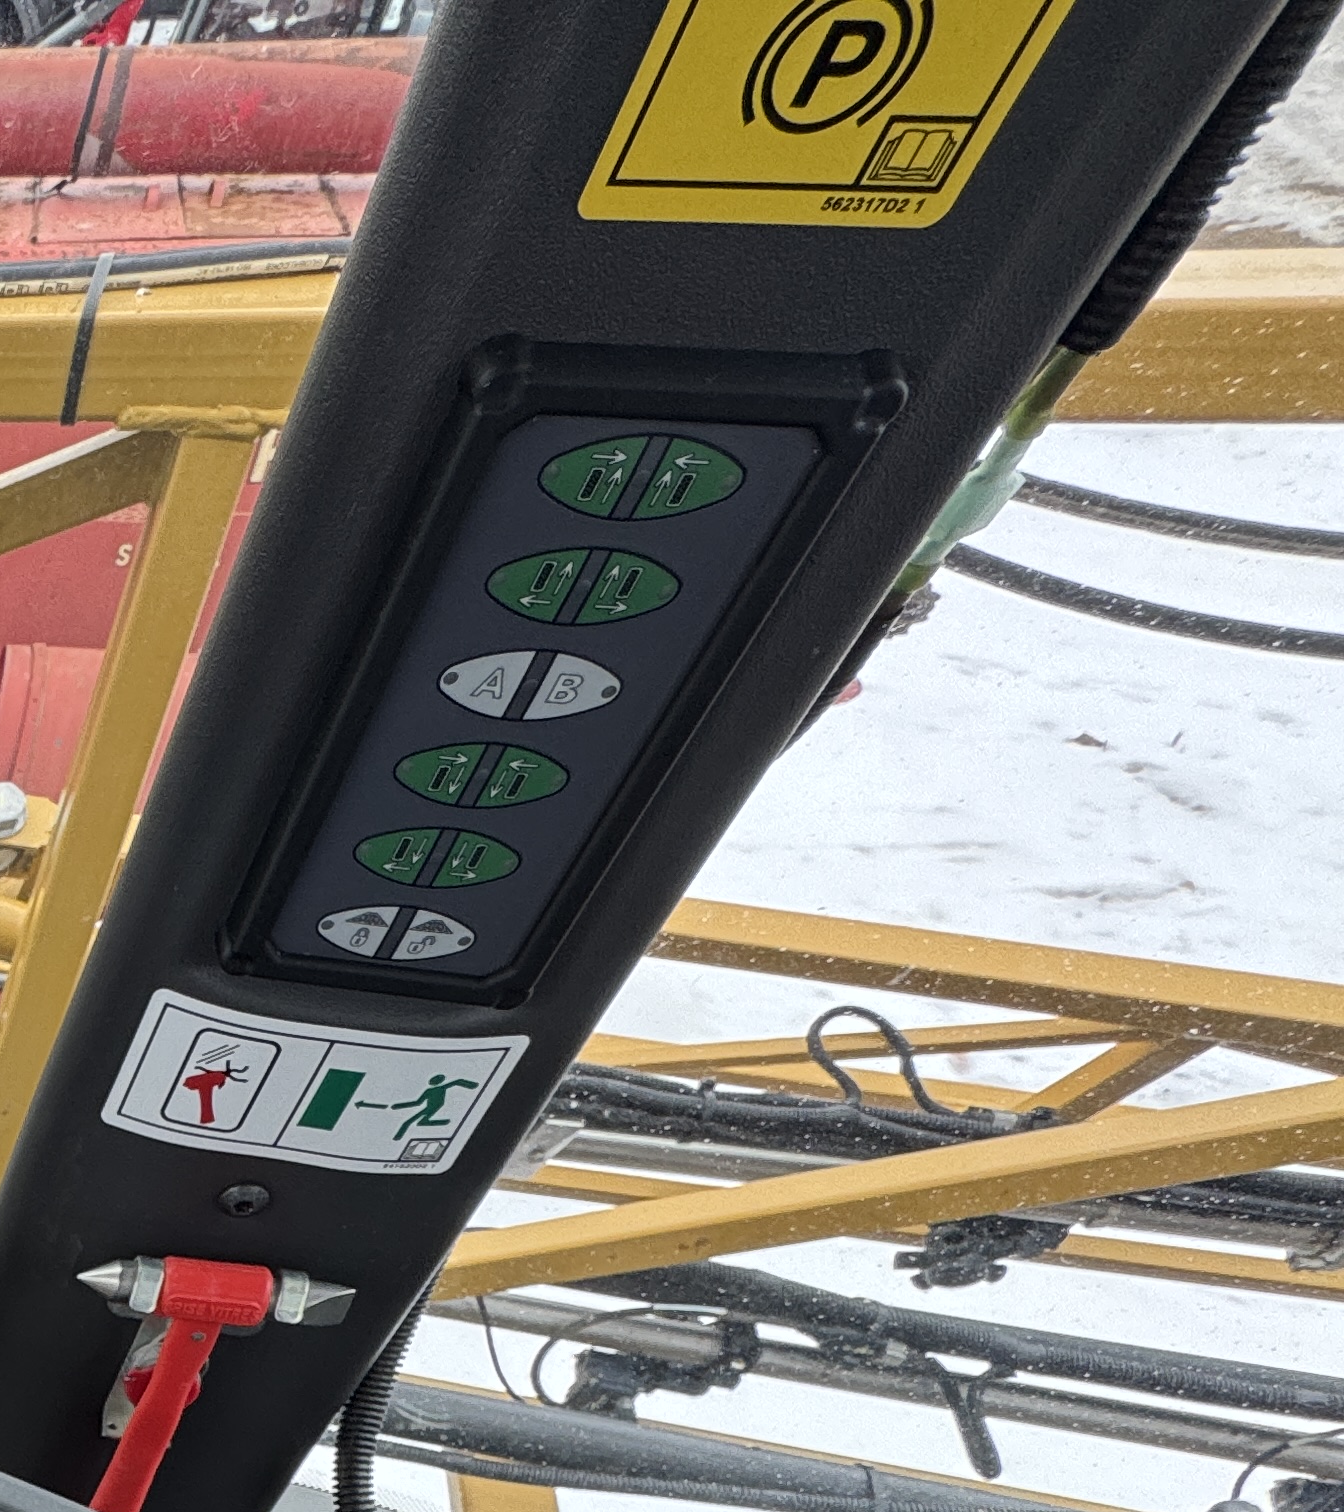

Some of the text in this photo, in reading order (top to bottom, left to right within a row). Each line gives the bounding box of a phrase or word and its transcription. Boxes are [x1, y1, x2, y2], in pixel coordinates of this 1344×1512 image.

[790, 18, 888, 108] P
[820, 196, 926, 214] 562317D2 1
[470, 667, 504, 699] A
[544, 673, 584, 704] B
